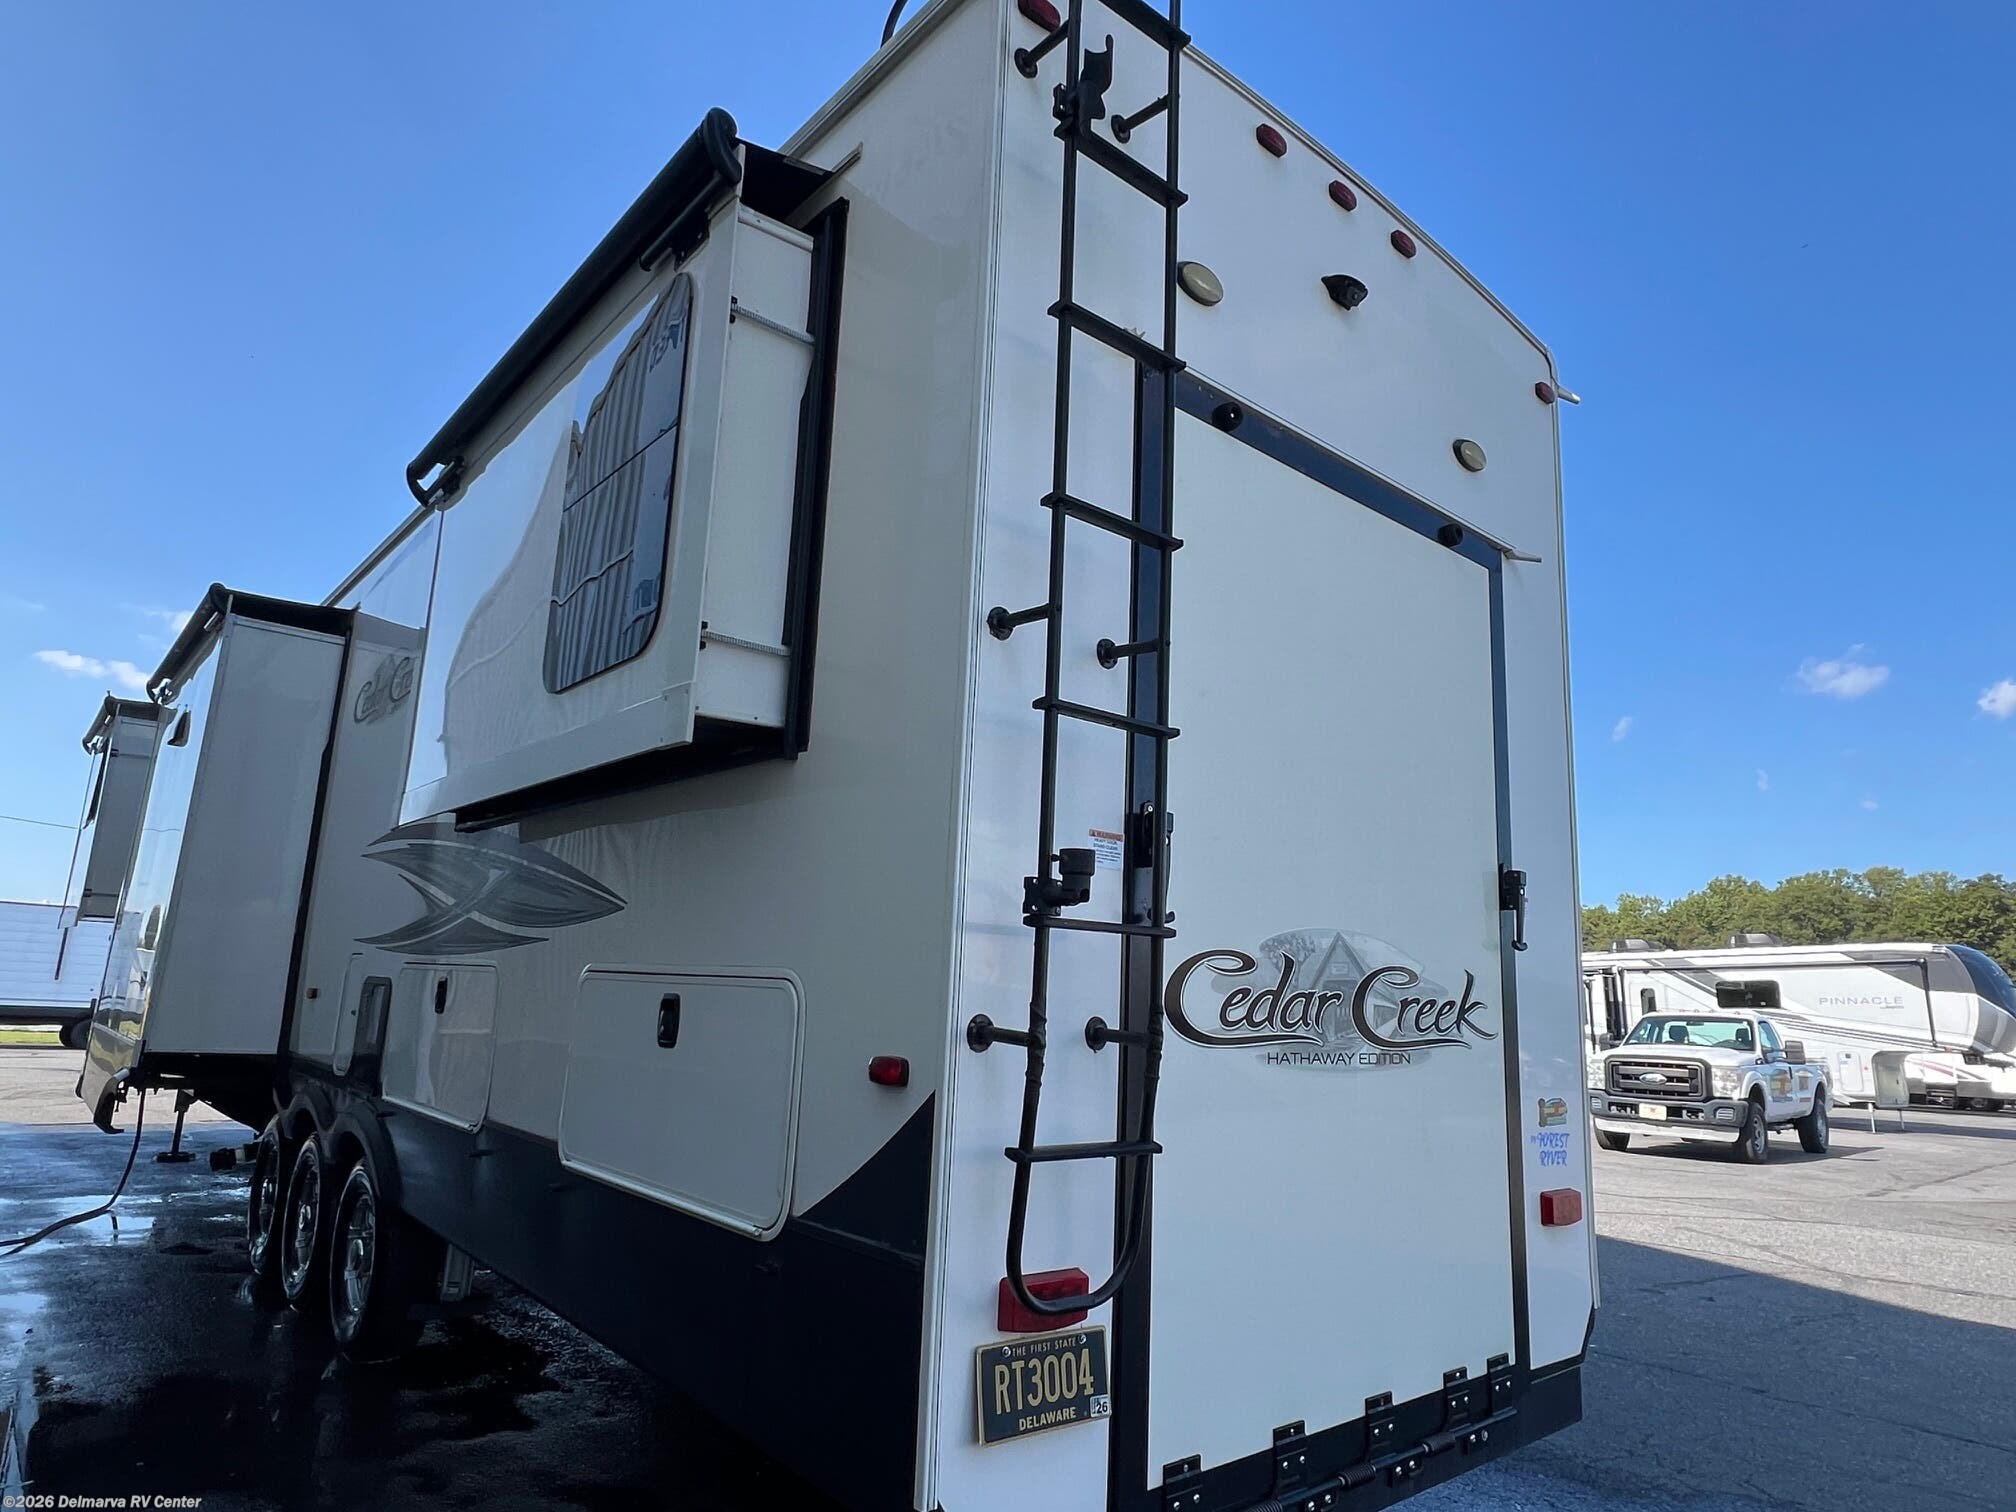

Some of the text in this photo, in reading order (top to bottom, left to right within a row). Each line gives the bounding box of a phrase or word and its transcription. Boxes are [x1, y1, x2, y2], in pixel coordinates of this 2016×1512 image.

[1163, 948, 1499, 1050] Cedar Creek
[1819, 996, 1903, 1005] PINNACLE
[1267, 1051, 1411, 1065] HATHAWAY EDITION
[1537, 1132, 1570, 1149] FOREST
[1540, 1150, 1568, 1167] RIVER
[1012, 1337, 1076, 1357] THE FIRST STATE
[994, 1348, 1094, 1415] RT3004
[1096, 1401, 1108, 1414] 26
[1019, 1407, 1077, 1431] DELAWARE
